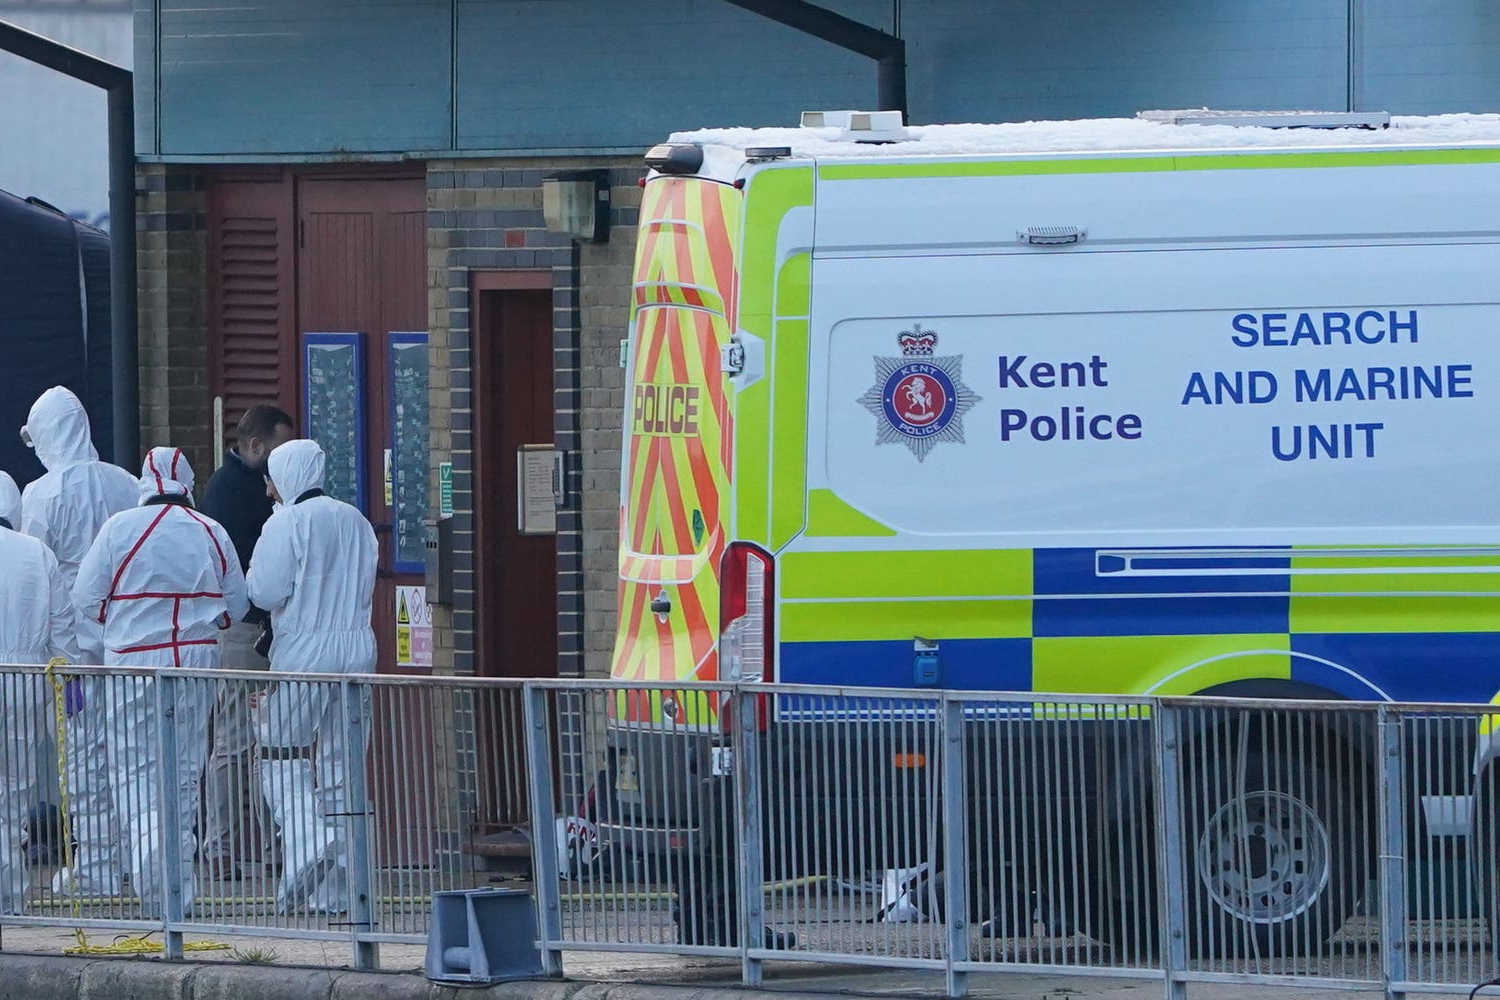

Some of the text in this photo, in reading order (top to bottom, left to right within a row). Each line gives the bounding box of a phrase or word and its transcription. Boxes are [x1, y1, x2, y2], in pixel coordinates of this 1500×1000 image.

[1231, 310, 1419, 348] SEARCH
[901, 365, 938, 376] KENT
[998, 355, 1108, 389] Kent
[1181, 364, 1474, 405] AND MARINE
[633, 384, 700, 434] POLICE
[999, 406, 1143, 442] Police
[900, 421, 943, 436] POLICE
[1271, 422, 1384, 462] UNIT
